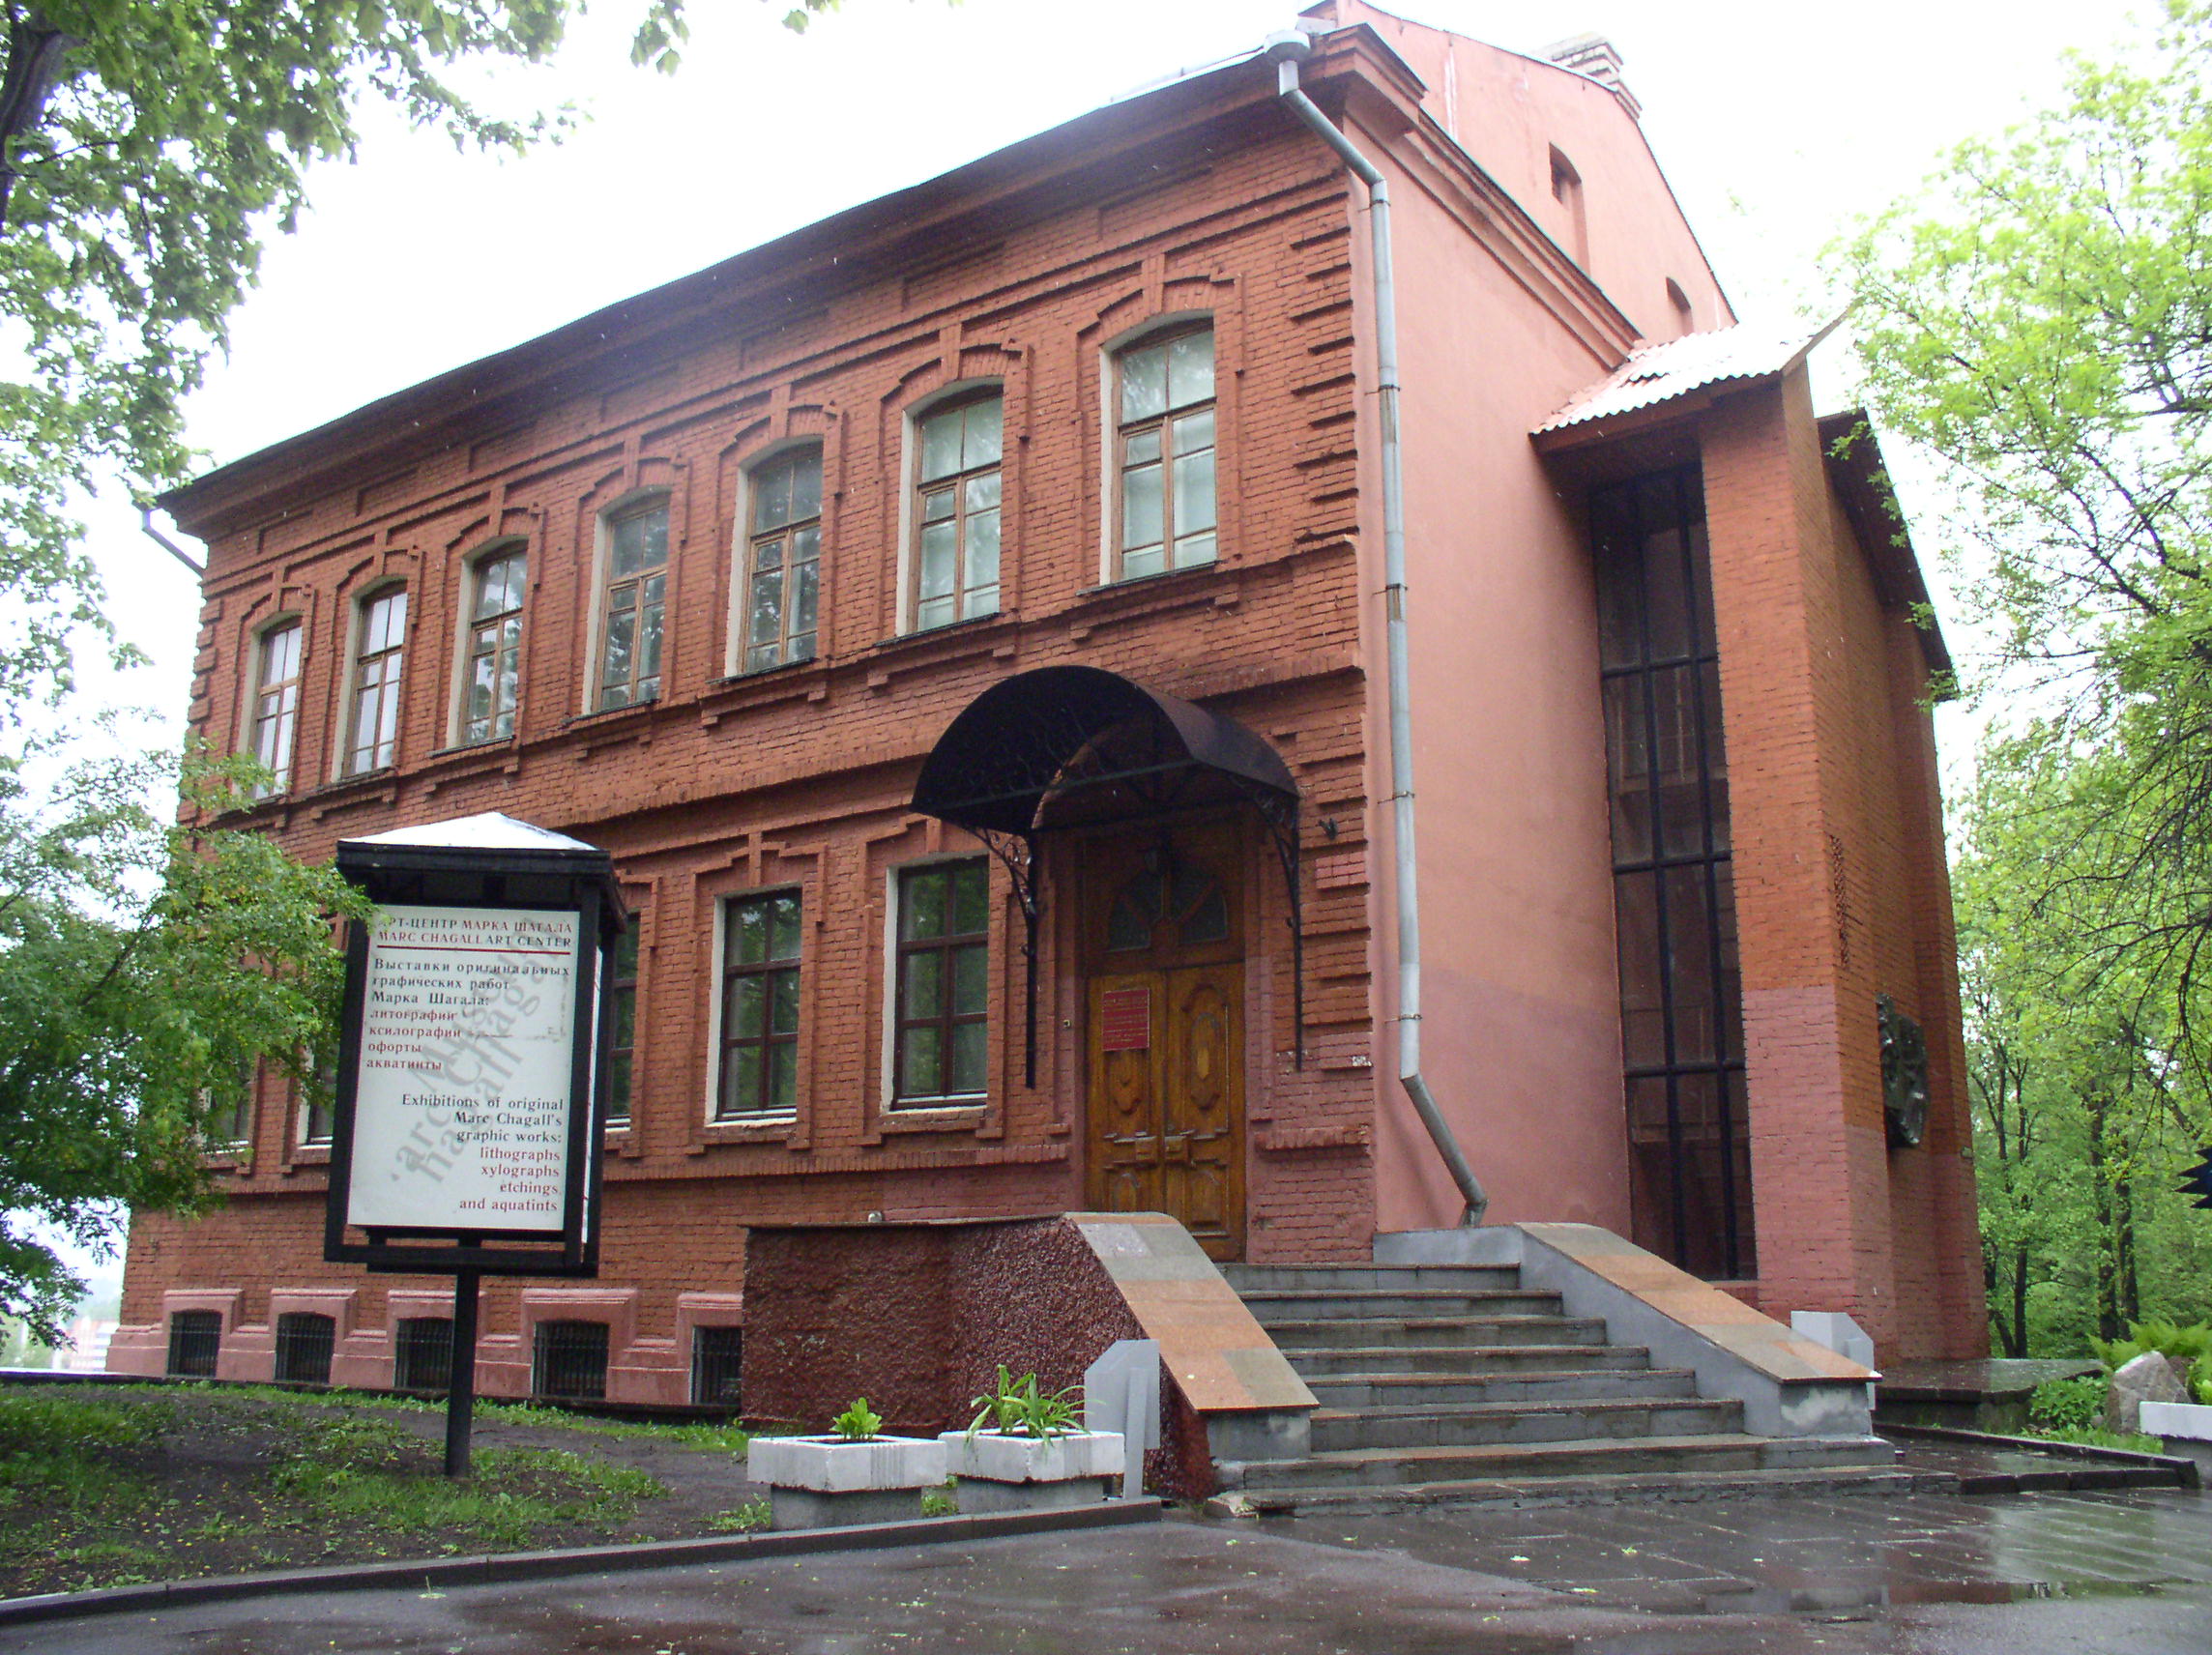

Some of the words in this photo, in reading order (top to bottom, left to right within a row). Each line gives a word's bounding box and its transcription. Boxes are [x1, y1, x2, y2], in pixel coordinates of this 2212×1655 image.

[463, 919, 508, 931] МАРКА
[514, 921, 572, 934] ШАГАЛА
[378, 931, 416, 942] MARC
[422, 933, 481, 944] CHAGALL
[485, 935, 510, 945] ART
[517, 936, 571, 947] CENTER
[375, 958, 450, 972] Выставки
[456, 964, 570, 976] оригинальных
[372, 975, 463, 989] графических
[470, 978, 509, 991] работ
[372, 990, 419, 1004] Марка
[429, 993, 489, 1006] Шагала:
[370, 1009, 455, 1023] литографии
[369, 1026, 461, 1039] ксилографии
[367, 1040, 422, 1055] офорты
[366, 1058, 442, 1071] акватинты
[402, 1093, 480, 1108] Exhibitions
[487, 1096, 500, 1108] of
[509, 1097, 564, 1112] original
[454, 1111, 490, 1124] Marc
[497, 1113, 563, 1127] Chagall's
[456, 1129, 509, 1144] graphic
[516, 1131, 562, 1145] works:
[480, 1147, 561, 1163] lithographs
[481, 1163, 560, 1179] xylographs
[459, 1198, 485, 1210] and
[491, 1199, 558, 1213] aquatints
